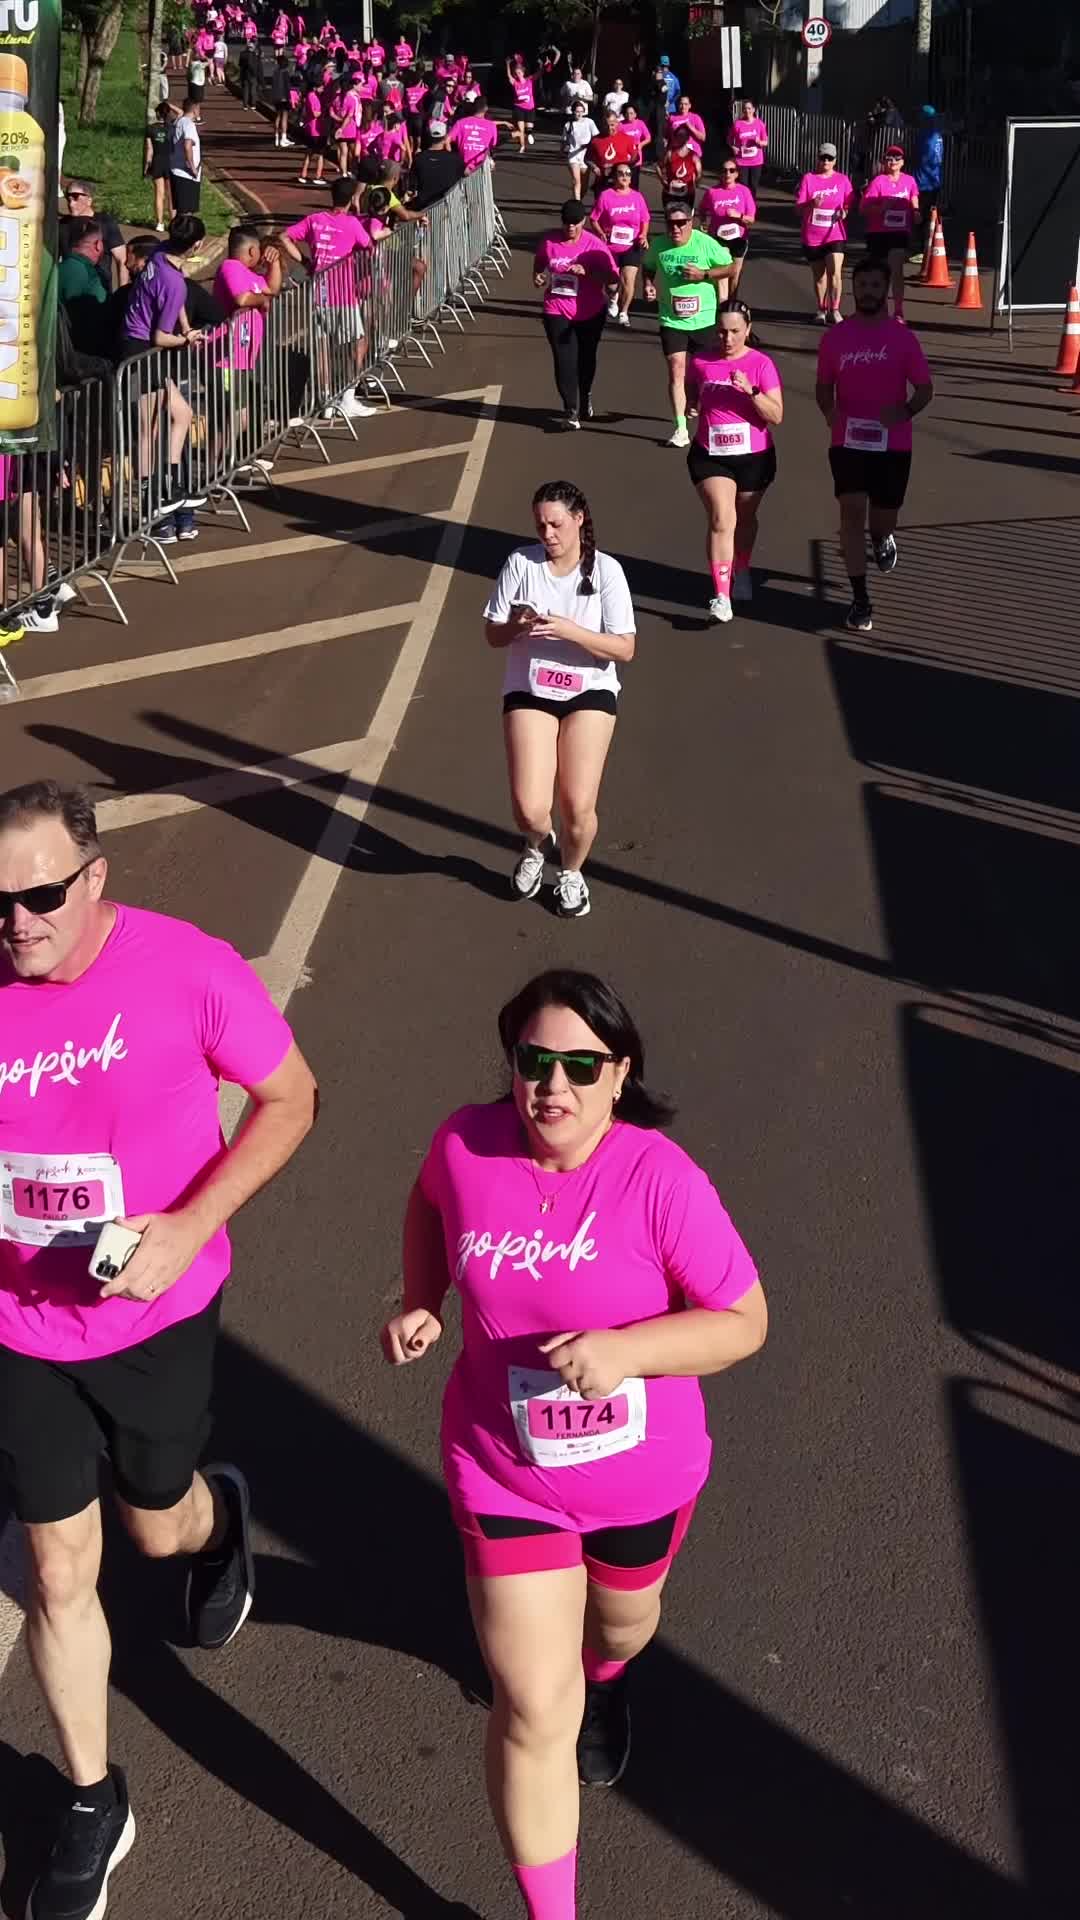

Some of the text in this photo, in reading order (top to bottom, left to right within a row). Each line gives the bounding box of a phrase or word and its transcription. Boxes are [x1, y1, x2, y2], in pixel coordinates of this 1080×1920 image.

[807, 23, 826, 35] 40
[1, 132, 29, 145] 20%
[718, 434, 742, 443] 1063
[546, 671, 573, 687] 705
[24, 1184, 91, 1212] 1176
[455, 1211, 599, 1281] gopink
[541, 1402, 615, 1430] 1174
[556, 1429, 601, 1440] FERNANDA
